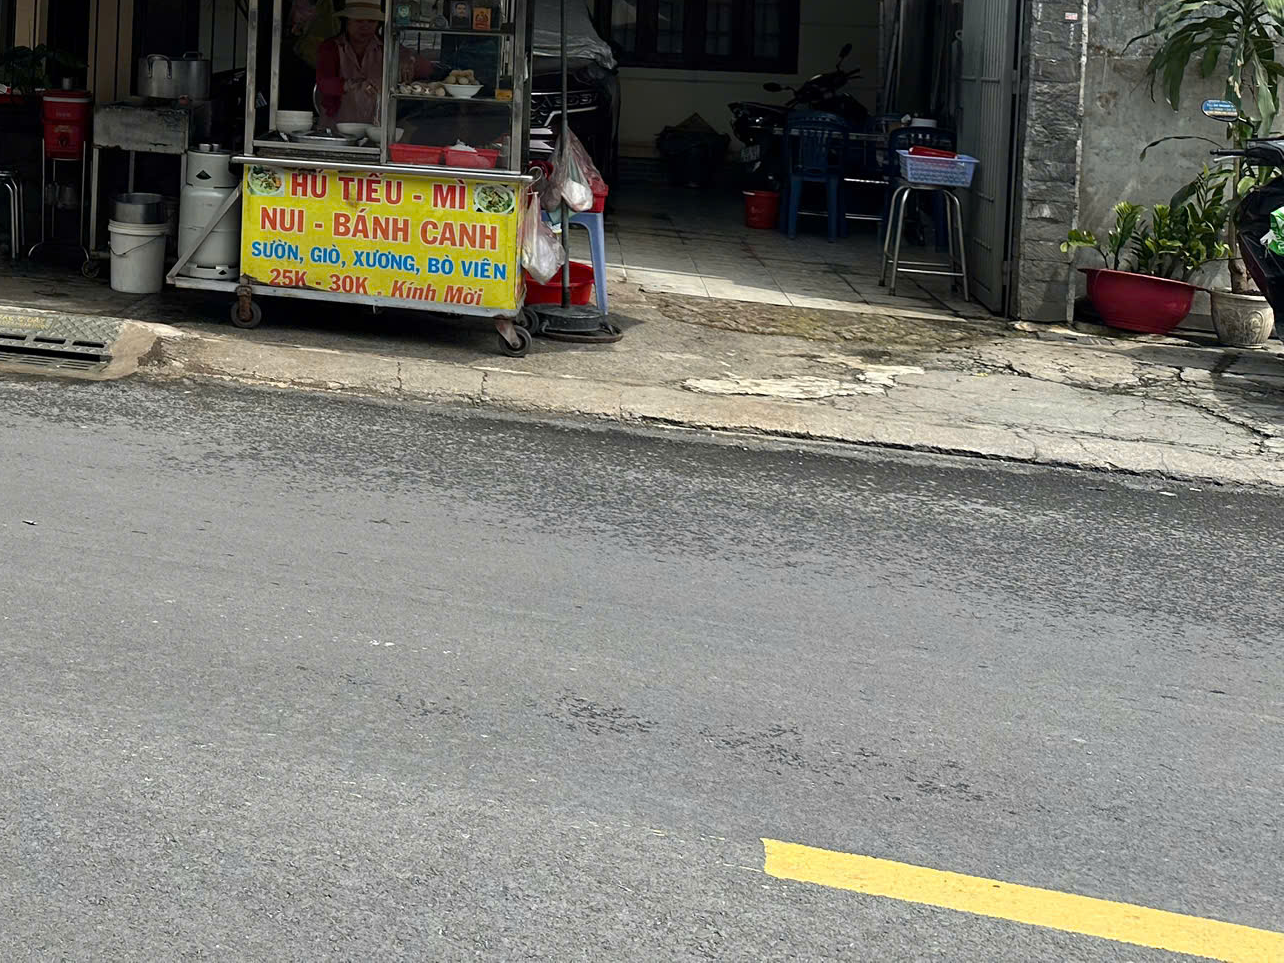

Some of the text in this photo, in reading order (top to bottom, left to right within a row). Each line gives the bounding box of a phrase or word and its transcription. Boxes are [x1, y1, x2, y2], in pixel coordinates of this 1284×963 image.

[432, 179, 466, 210] MÌ
[260, 207, 305, 233] NUI
[333, 208, 410, 243] BÁNH
[420, 220, 498, 250] CANH
[251, 239, 507, 280] SƯỜN, GIÒ, XƯƠNG, BÒ VIÊN
[269, 269, 308, 287] 25K
[329, 274, 369, 295] 30K
[390, 280, 436, 302] Kính
[443, 285, 484, 306] Mời
